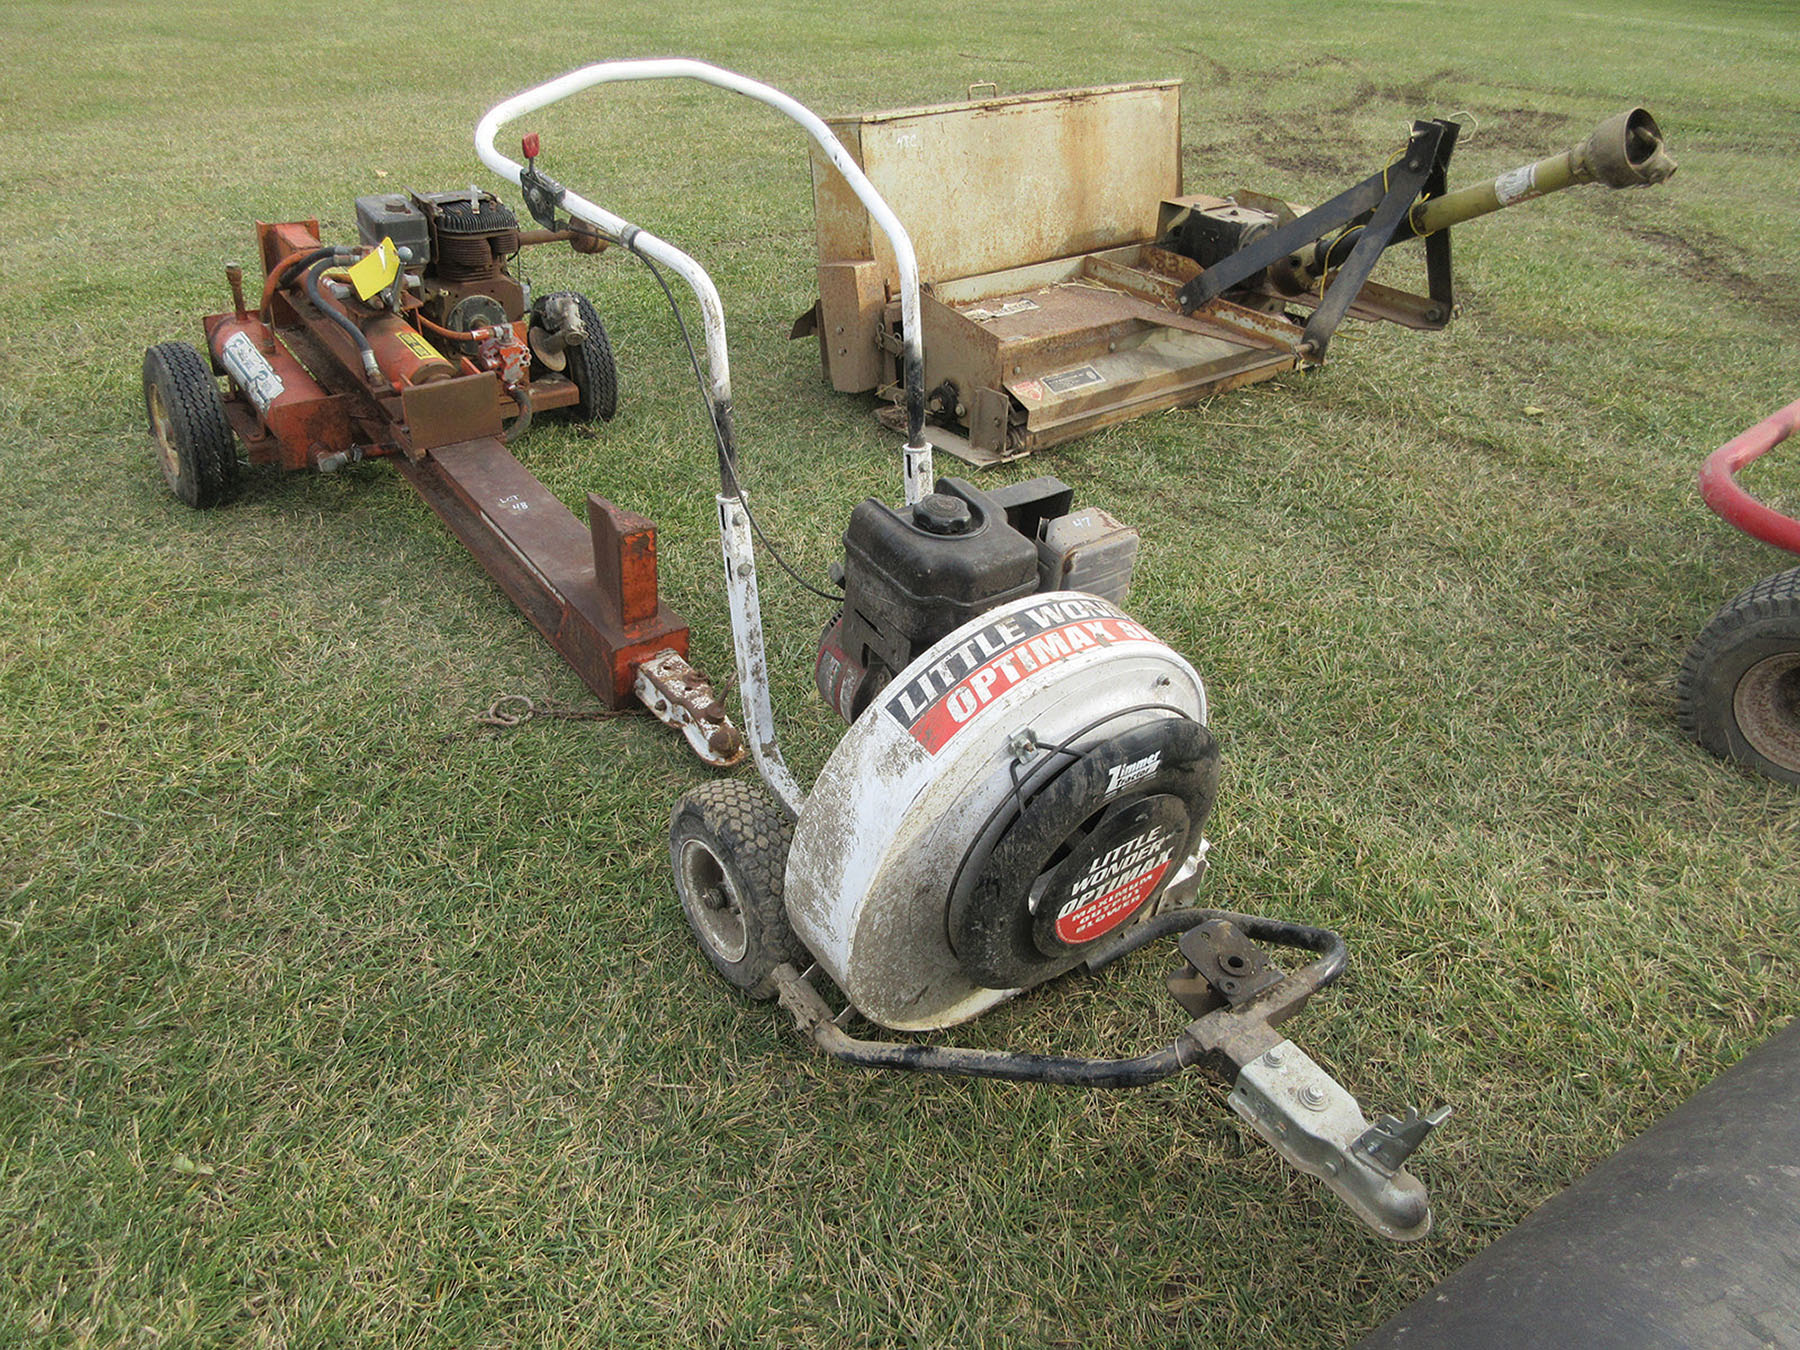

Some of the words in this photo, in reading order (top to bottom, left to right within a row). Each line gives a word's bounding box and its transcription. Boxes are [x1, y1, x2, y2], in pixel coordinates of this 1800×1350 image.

[511, 501, 529, 511] 48
[1072, 516, 1092, 528] 47
[898, 617, 1026, 721] LITTLE
[946, 620, 1117, 723] OPTIMAX
[1104, 750, 1161, 794] Zimmer
[1071, 838, 1164, 896] WONDER
[1089, 825, 1162, 873] LITTLE
[1057, 846, 1174, 919] OPTIMAX
[1072, 874, 1153, 922] MAXIMUM
[1076, 895, 1140, 934] BLOWER
[1079, 889, 1140, 925] OUTPUT
